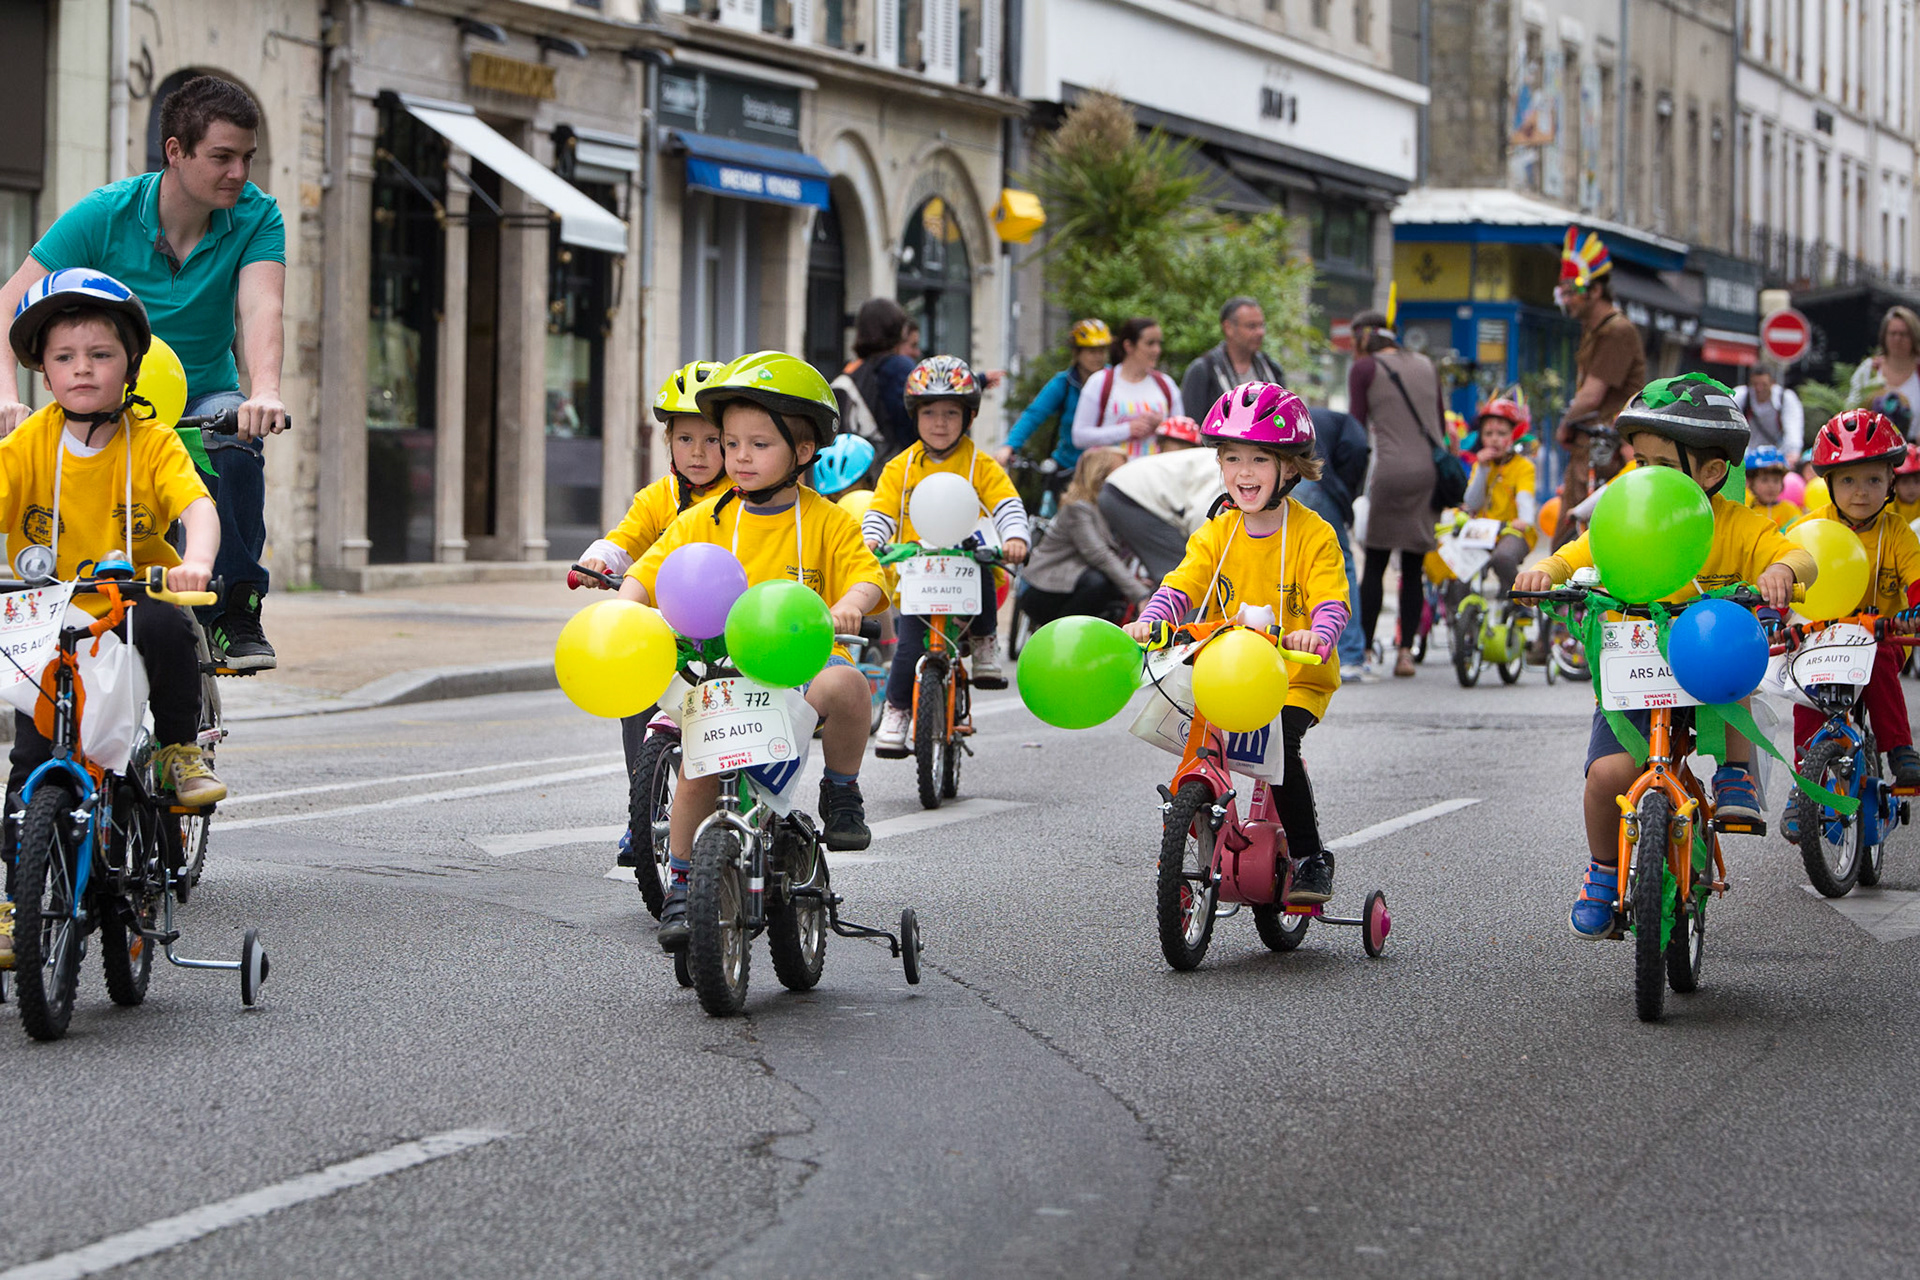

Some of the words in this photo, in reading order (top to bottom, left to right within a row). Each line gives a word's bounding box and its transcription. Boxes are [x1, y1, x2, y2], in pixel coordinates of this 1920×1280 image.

[955, 566, 975, 577] 778
[921, 586, 938, 594] ARS
[940, 586, 962, 594] AUTO
[1806, 655, 1823, 666] ARS
[1824, 655, 1850, 664] AUTO
[1629, 668, 1654, 679] ARS
[1657, 667, 1674, 678] AU
[744, 691, 770, 708] 772
[1652, 699, 1673, 707] JUIN
[703, 728, 726, 743] ARS
[729, 722, 763, 737] AUTO
[719, 762, 726, 770] 5
[727, 758, 748, 769] JUIN
